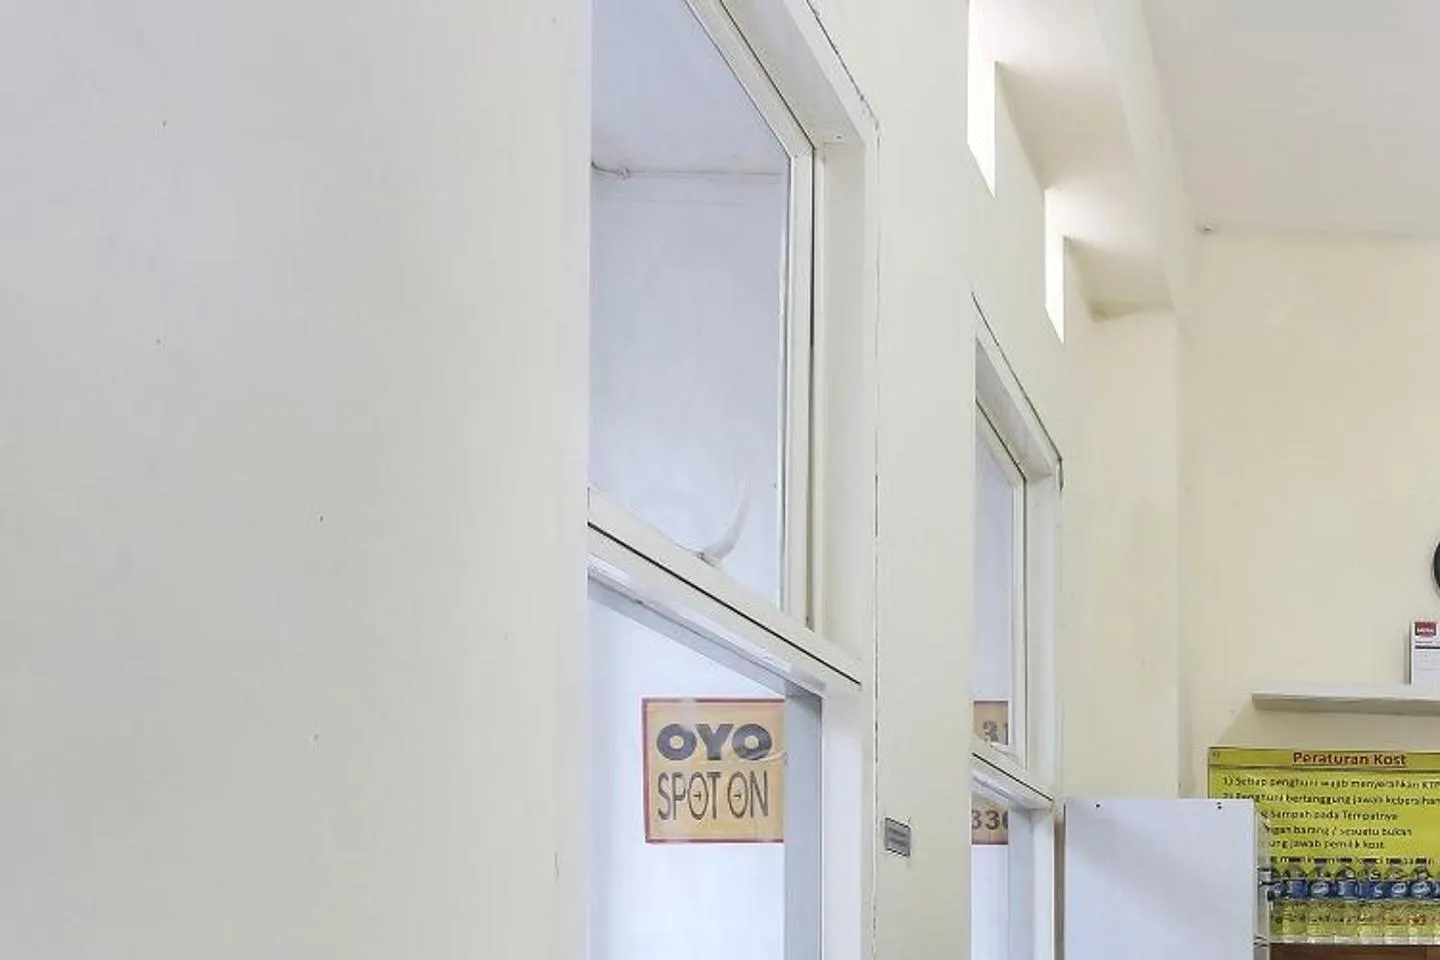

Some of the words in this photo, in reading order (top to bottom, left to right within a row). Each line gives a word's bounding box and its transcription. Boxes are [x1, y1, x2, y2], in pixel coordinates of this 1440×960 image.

[656, 723, 773, 761] OYO
[1293, 752, 1369, 766] Peraturan
[1374, 753, 1407, 766] Kost
[657, 771, 722, 820] SPOT
[727, 770, 770, 819] ON
